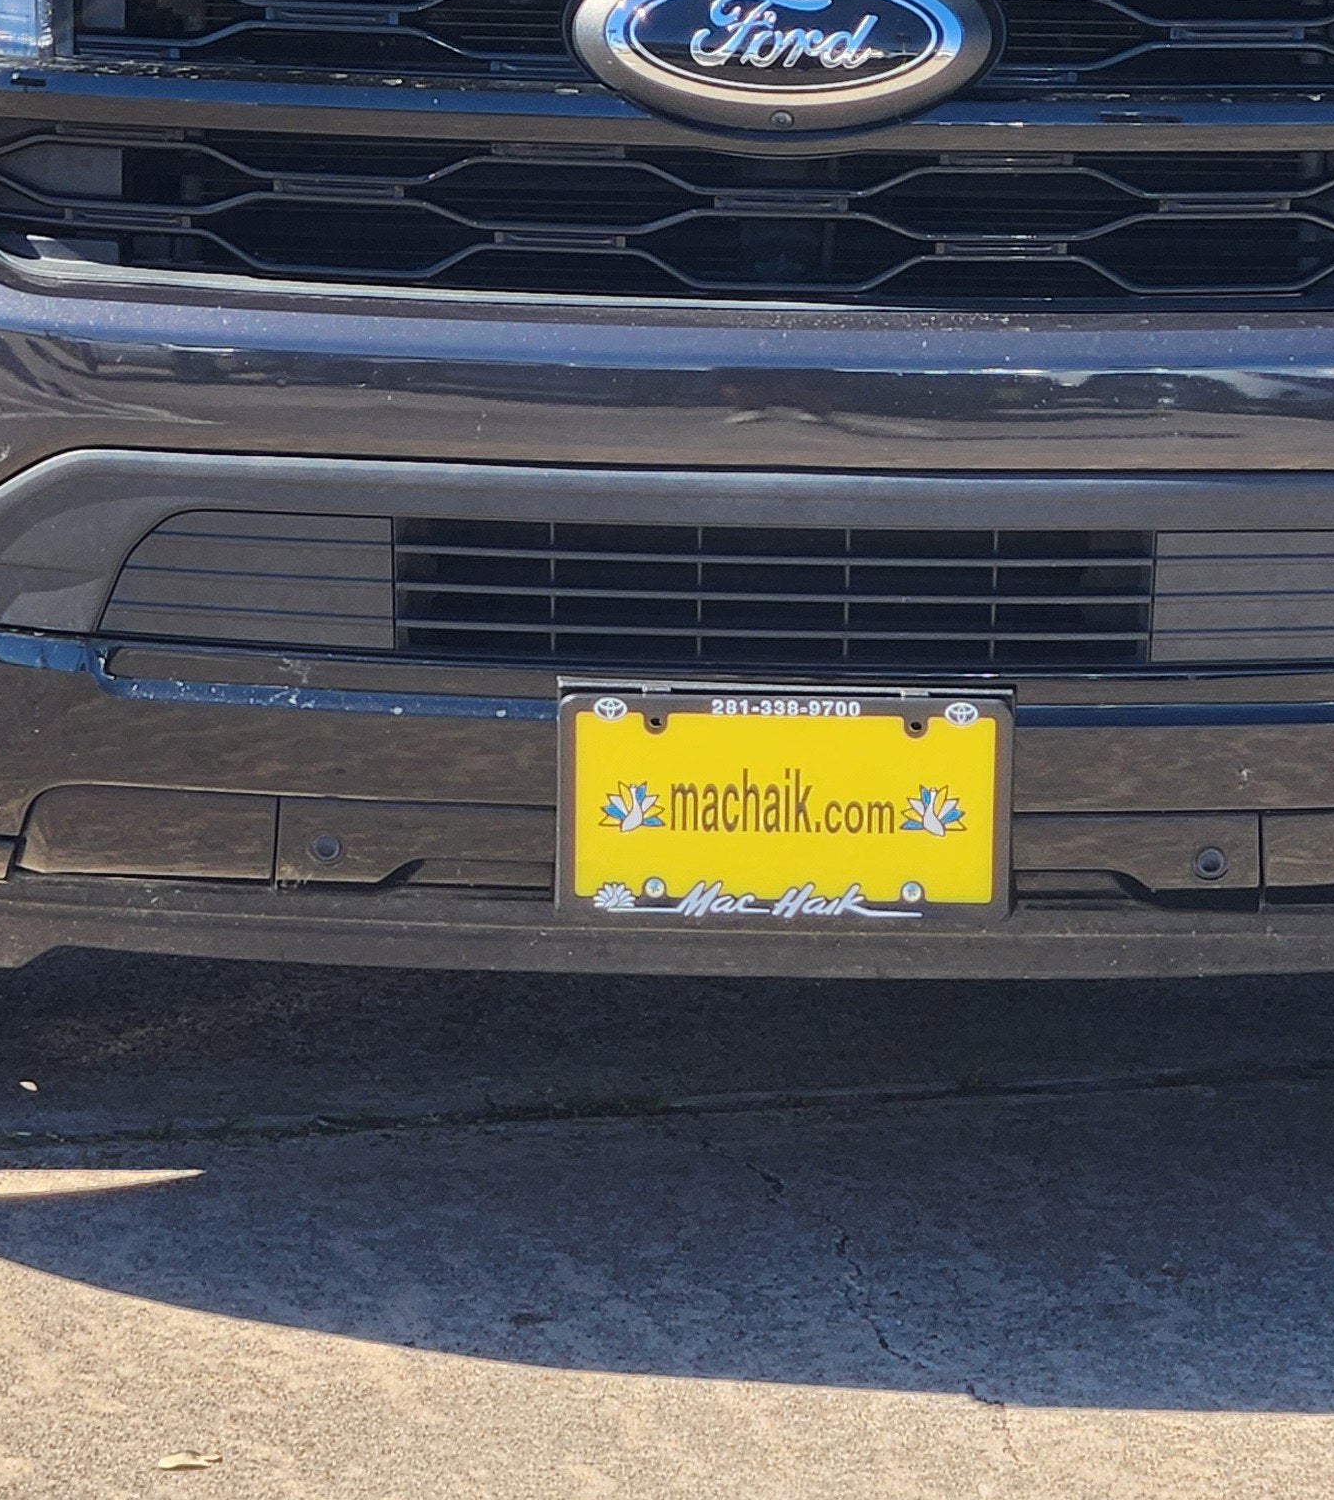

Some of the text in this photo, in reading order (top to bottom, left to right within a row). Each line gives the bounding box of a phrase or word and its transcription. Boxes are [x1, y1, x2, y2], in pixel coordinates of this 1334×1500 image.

[711, 699, 861, 717] 281-338-9700
[670, 768, 895, 834] machaik.com
[675, 880, 923, 918] Mac Haik
